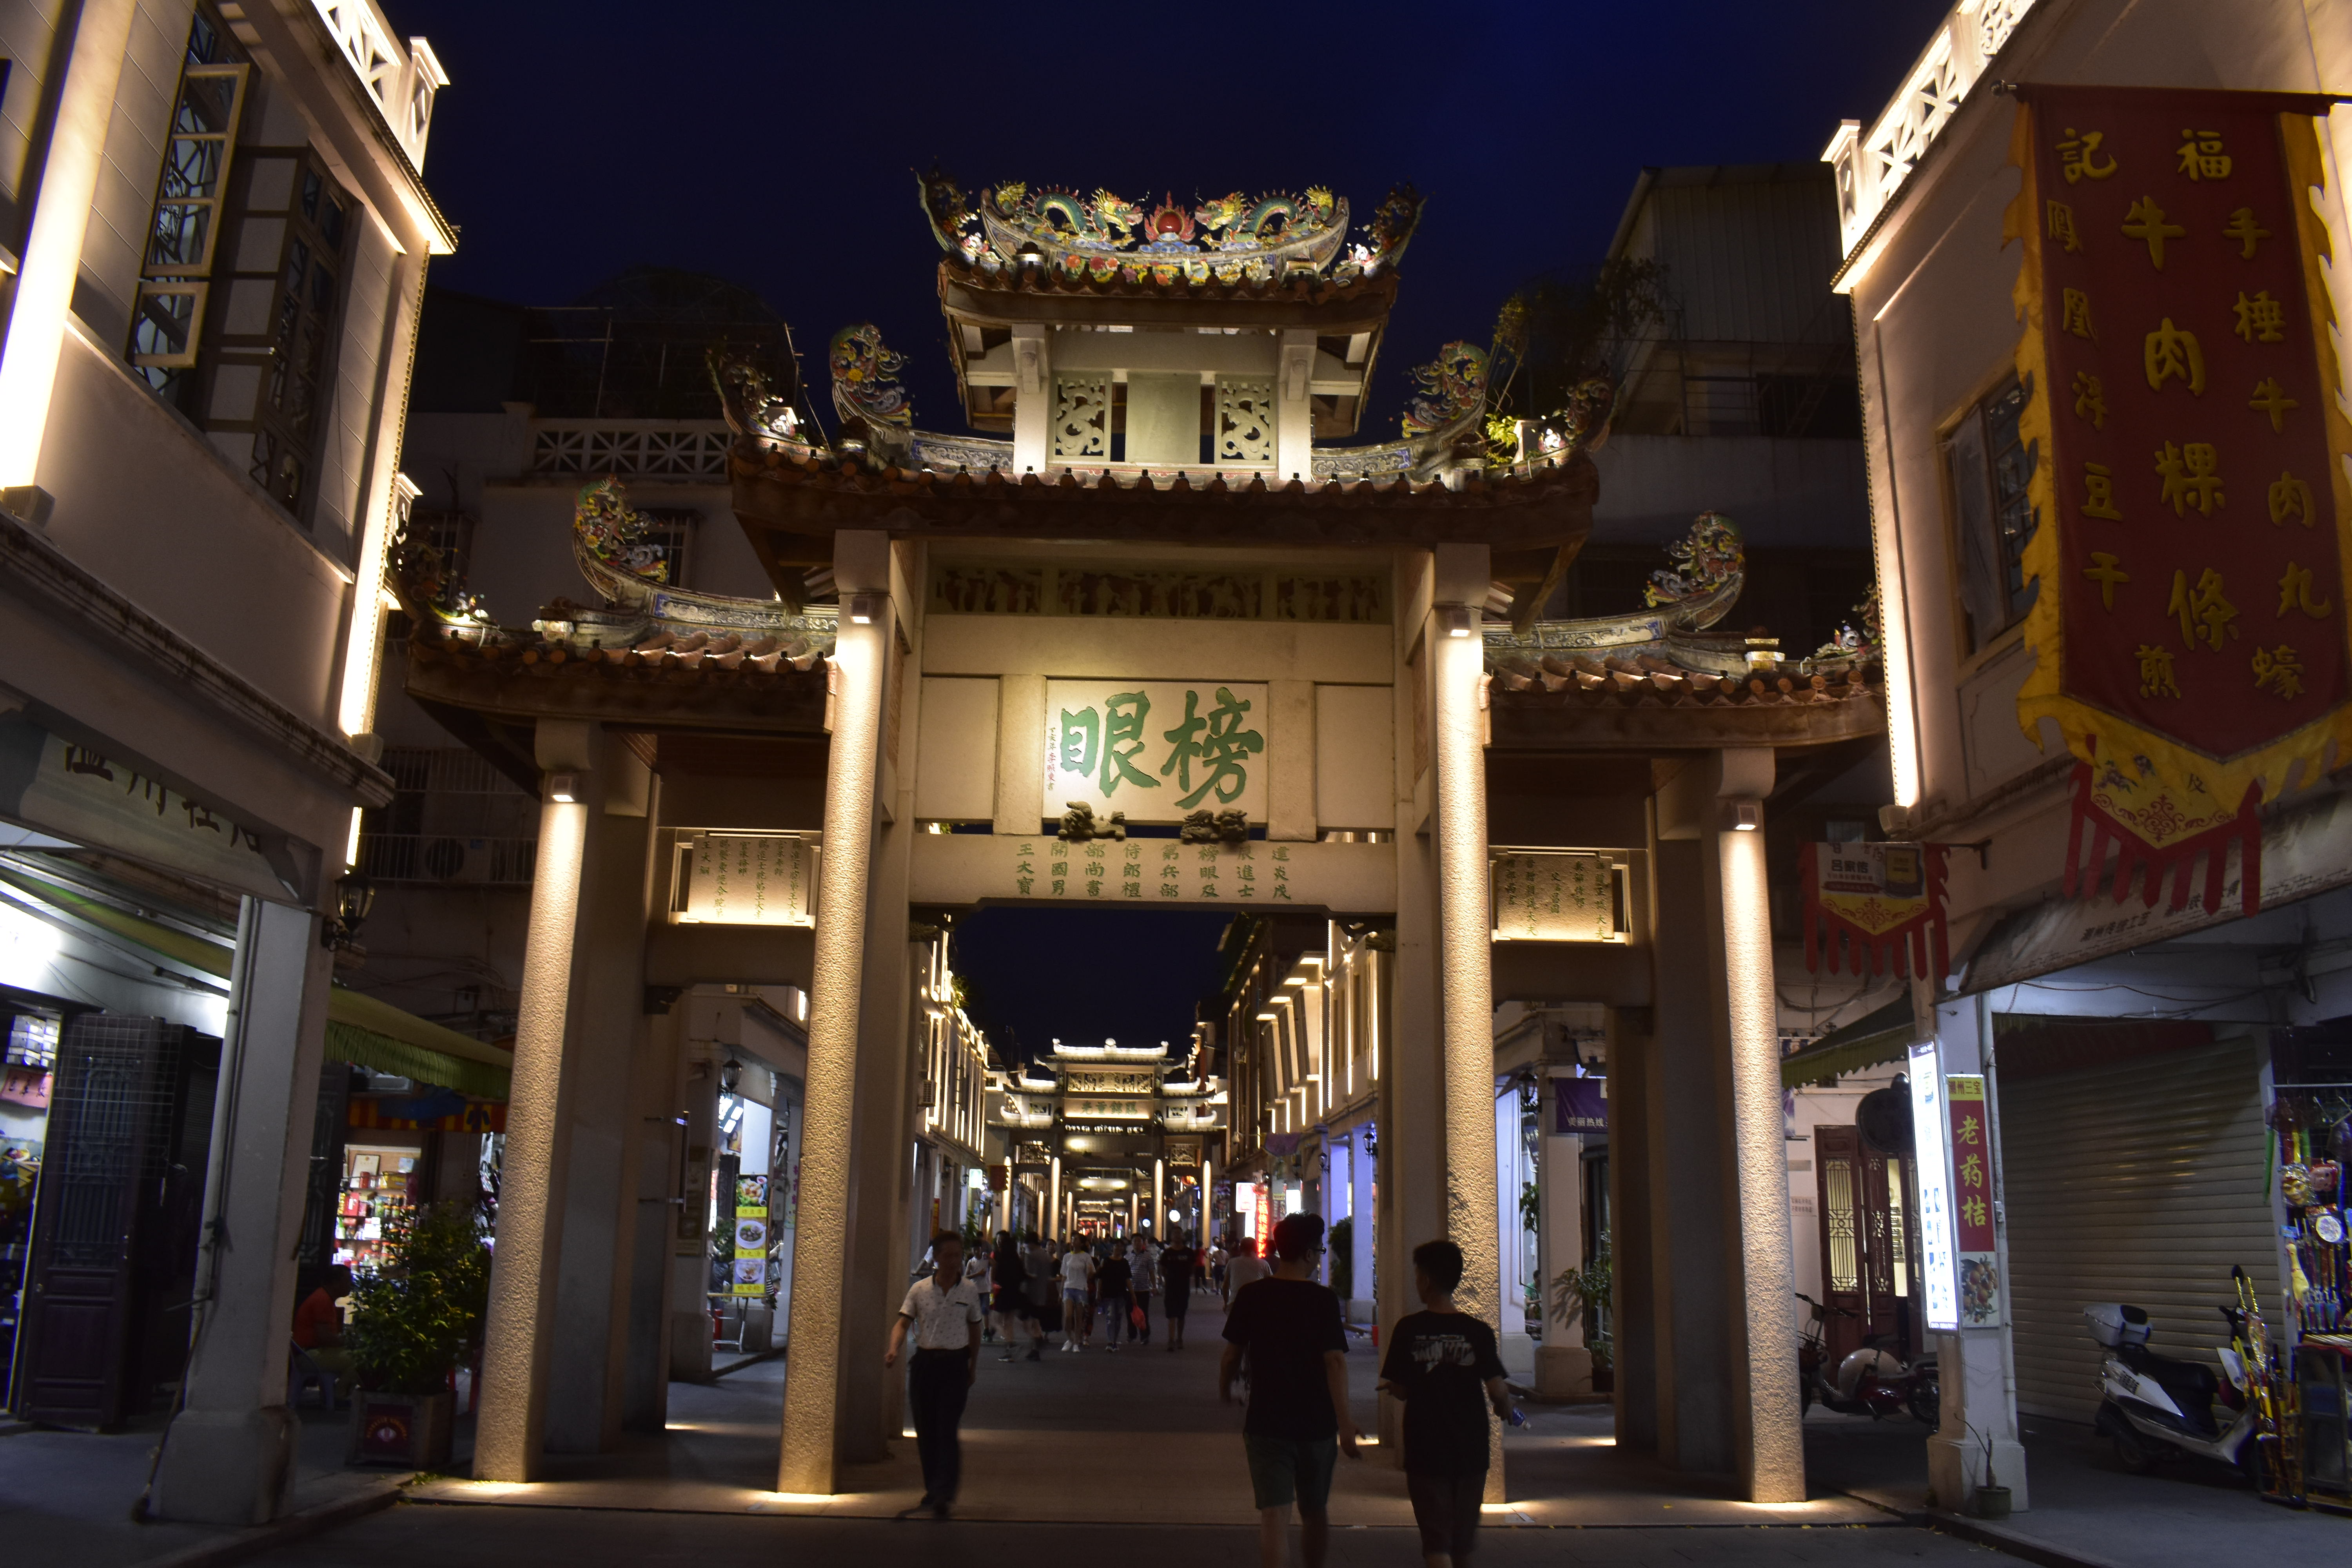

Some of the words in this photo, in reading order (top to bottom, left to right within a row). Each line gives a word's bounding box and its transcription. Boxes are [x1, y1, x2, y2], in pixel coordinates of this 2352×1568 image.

[2120, 196, 2240, 652] 牛肉粿條
[1956, 1115, 1987, 1228] 老药桔
